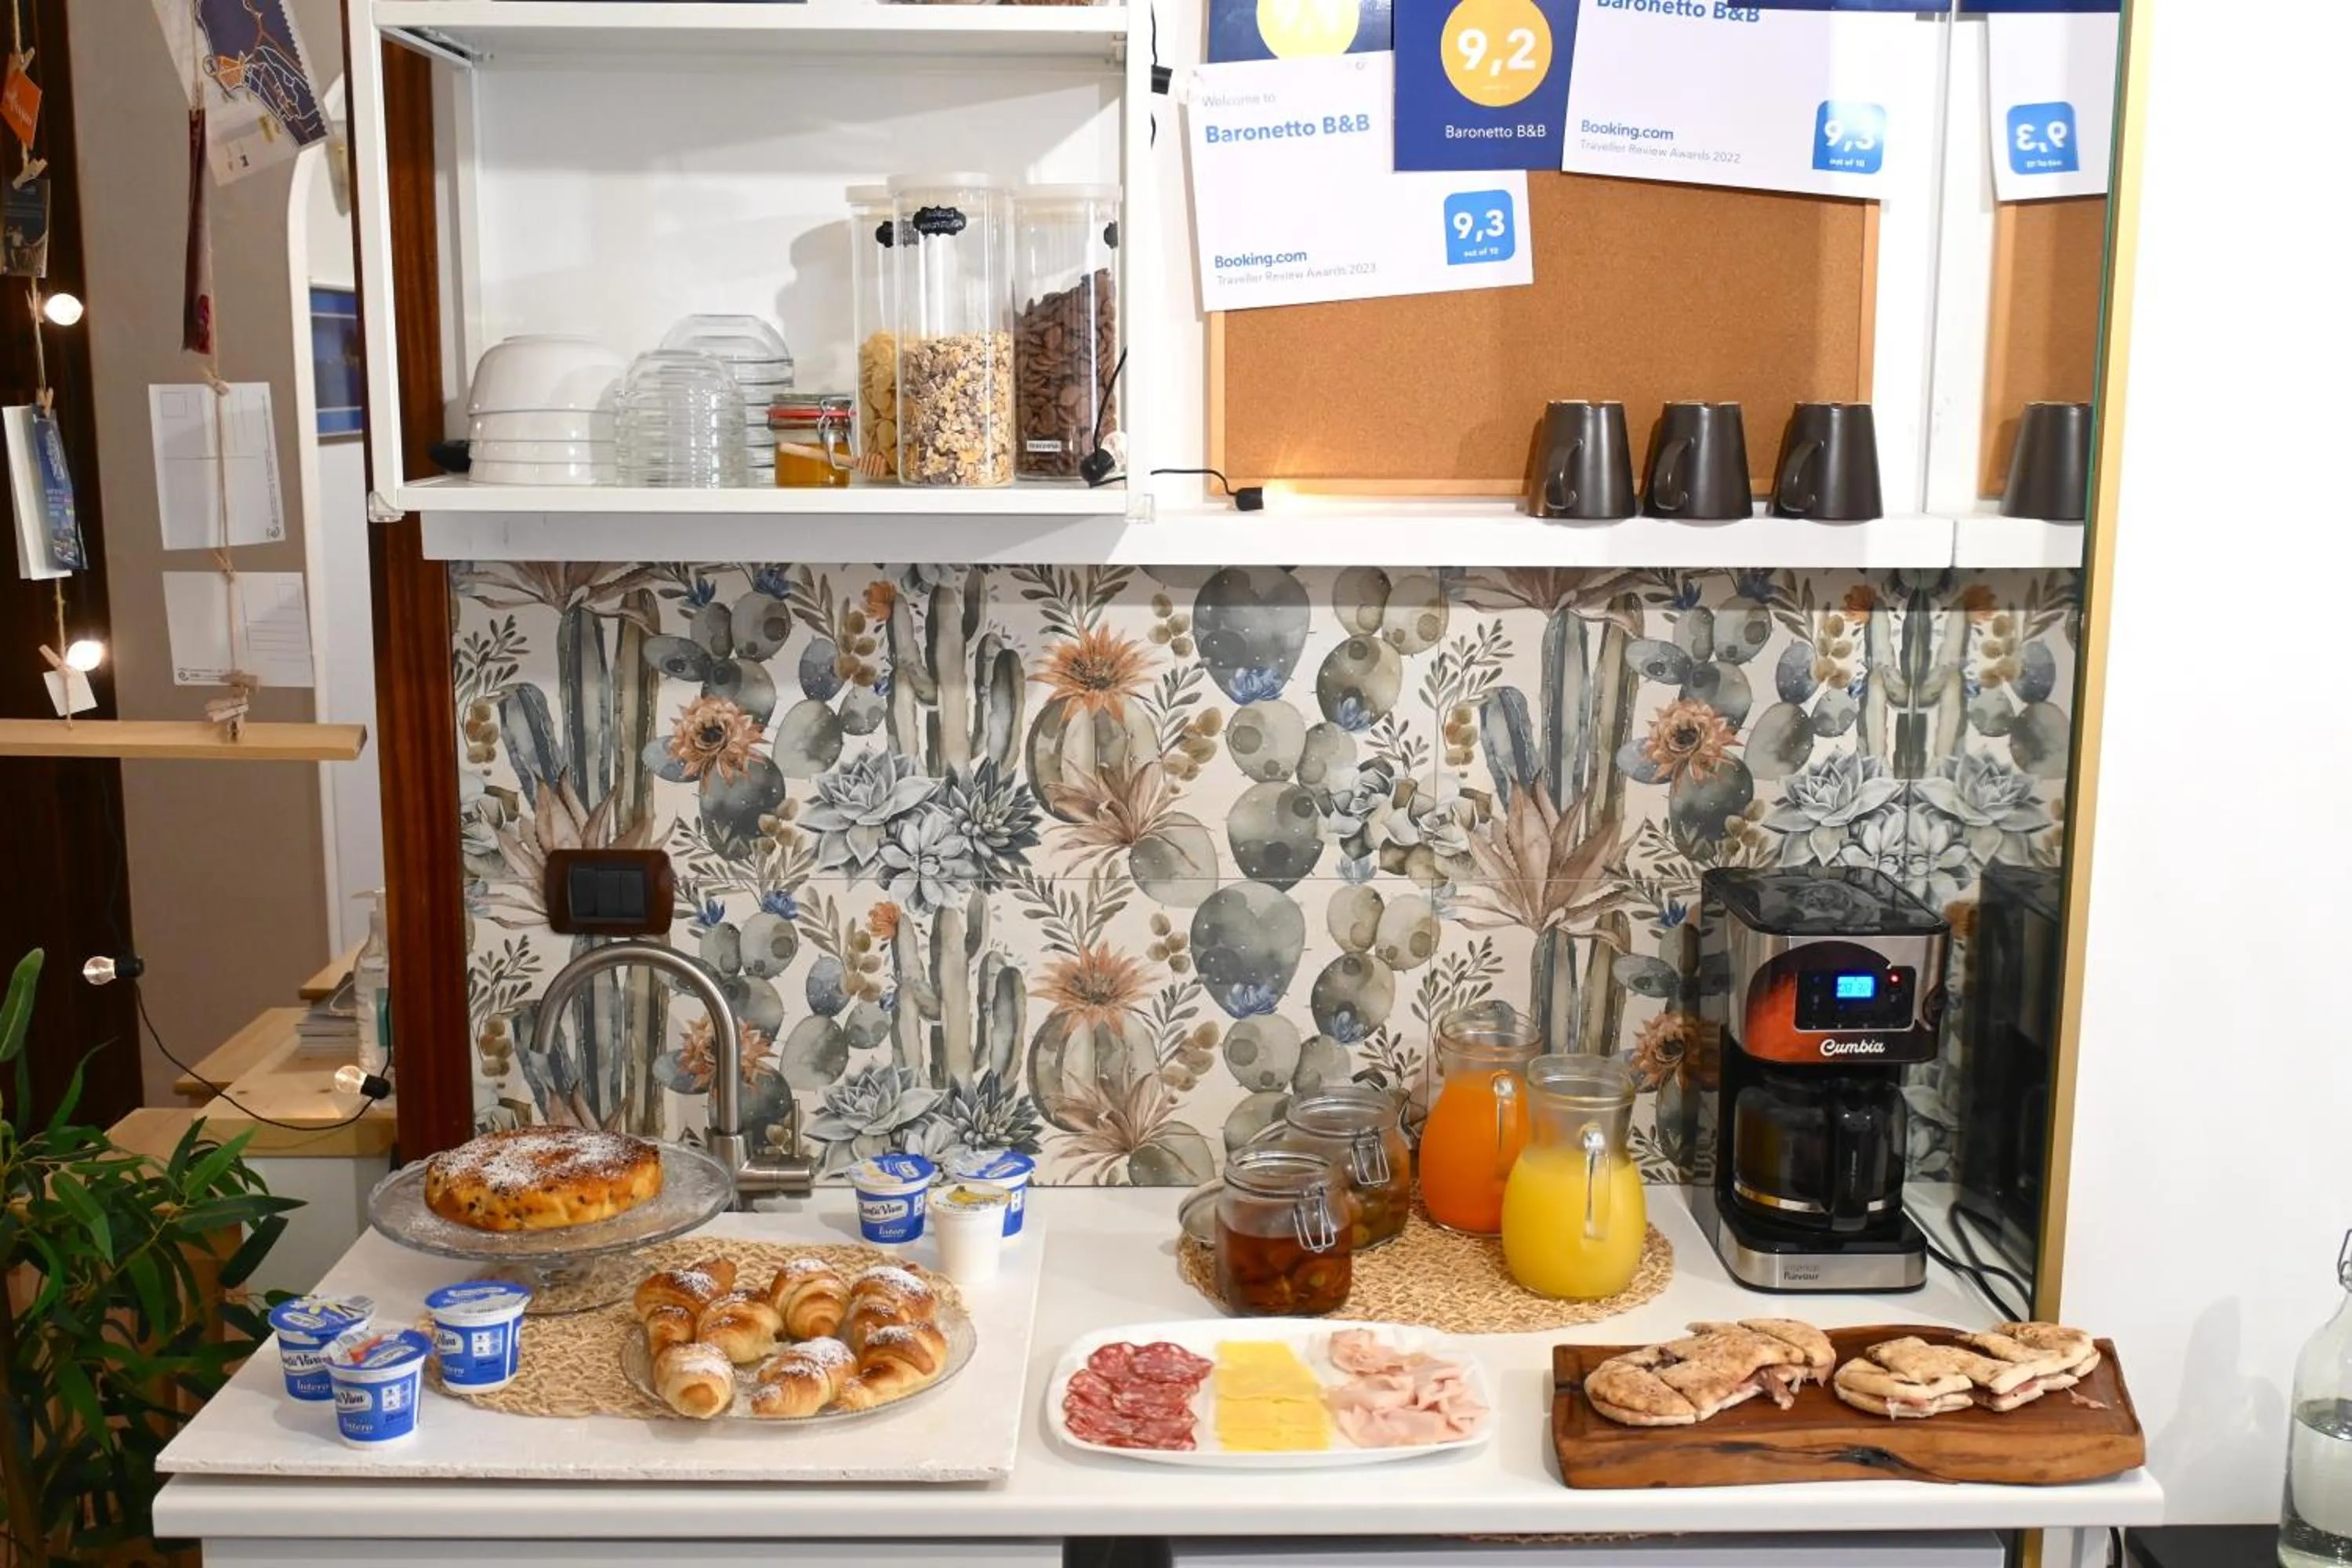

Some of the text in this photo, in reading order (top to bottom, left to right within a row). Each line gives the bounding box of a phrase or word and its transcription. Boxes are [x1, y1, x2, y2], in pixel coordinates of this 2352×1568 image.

[1714, 2, 1760, 23] B&B
[1457, 28, 1536, 76] 9,2
[1203, 93, 1276, 107] Welcome to
[1206, 114, 1370, 143] Baronetto B&B
[1445, 124, 1547, 139] Baronetto B&B
[1581, 119, 1675, 141] Booking.com
[1628, 143, 1667, 158] Review
[1670, 147, 1711, 161] Awards
[1713, 151, 1742, 164] 2022
[1453, 209, 1505, 242] 9,3
[1214, 252, 1307, 268] Booking.com
[1265, 270, 1304, 282] Review
[1349, 263, 1377, 274] 2023
[1820, 1038, 1886, 1056] Cumbia
